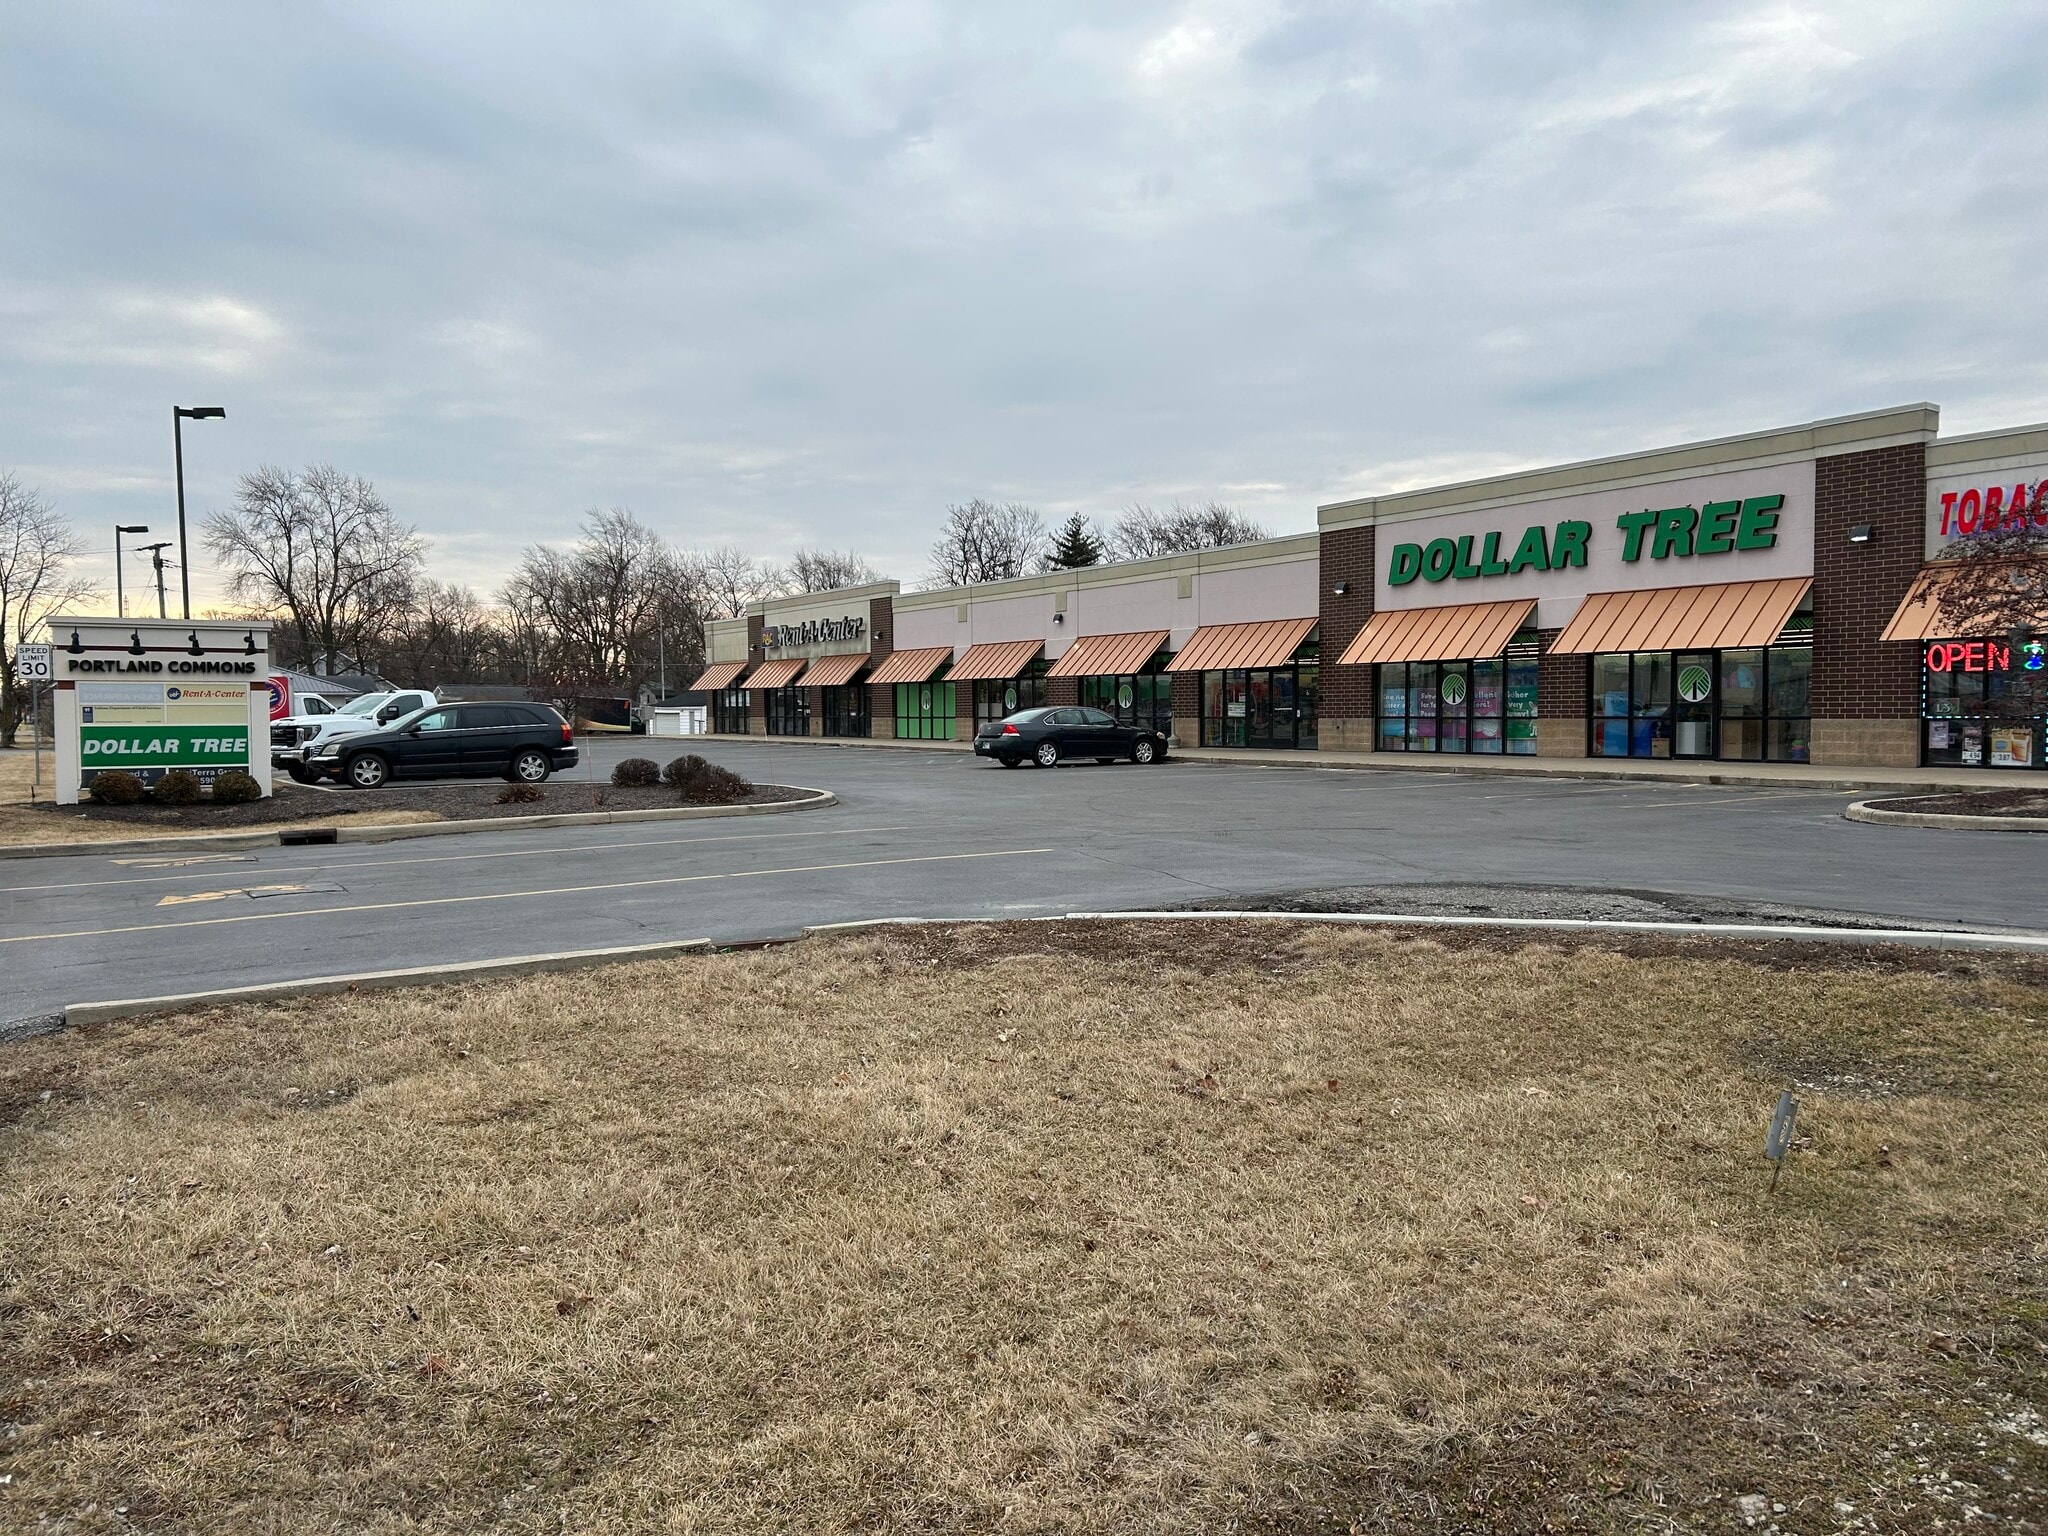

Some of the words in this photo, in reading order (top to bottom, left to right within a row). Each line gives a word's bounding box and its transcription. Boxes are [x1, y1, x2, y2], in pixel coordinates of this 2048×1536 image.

[1387, 520, 1593, 586] DOLLAR
[1616, 493, 1786, 562] TREE
[1927, 642, 2010, 672] OPEN
[21, 662, 48, 676] 30
[68, 659, 163, 673] PORTLAND
[168, 660, 256, 674] COMMONS
[83, 738, 180, 755] DOLLAR
[190, 738, 248, 753] TREE
